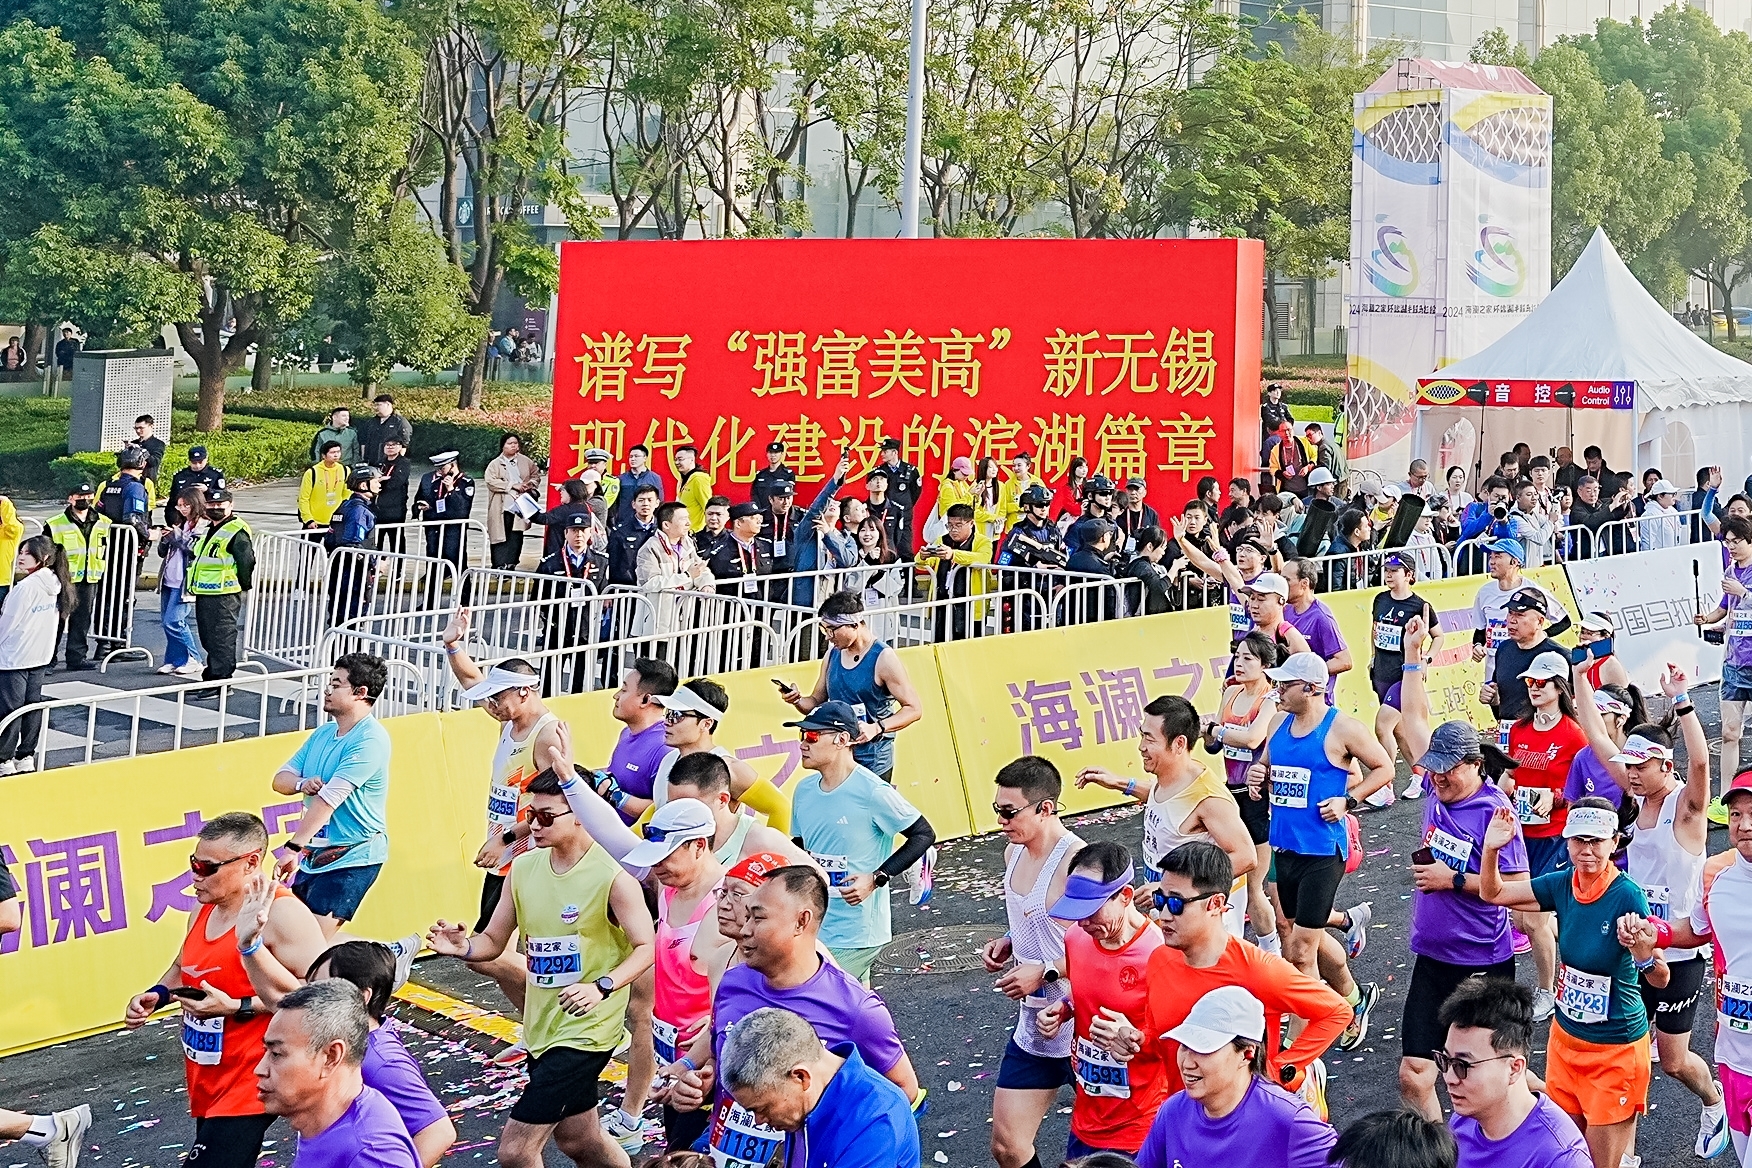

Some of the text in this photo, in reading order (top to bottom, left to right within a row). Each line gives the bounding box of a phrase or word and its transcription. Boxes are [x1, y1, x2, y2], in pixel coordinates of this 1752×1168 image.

[1588, 385, 1611, 394] Audio
[1581, 395, 1611, 405] Control
[530, 954, 574, 974] 21292
[1563, 984, 1603, 1015] 33423
[720, 1106, 728, 1119] B
